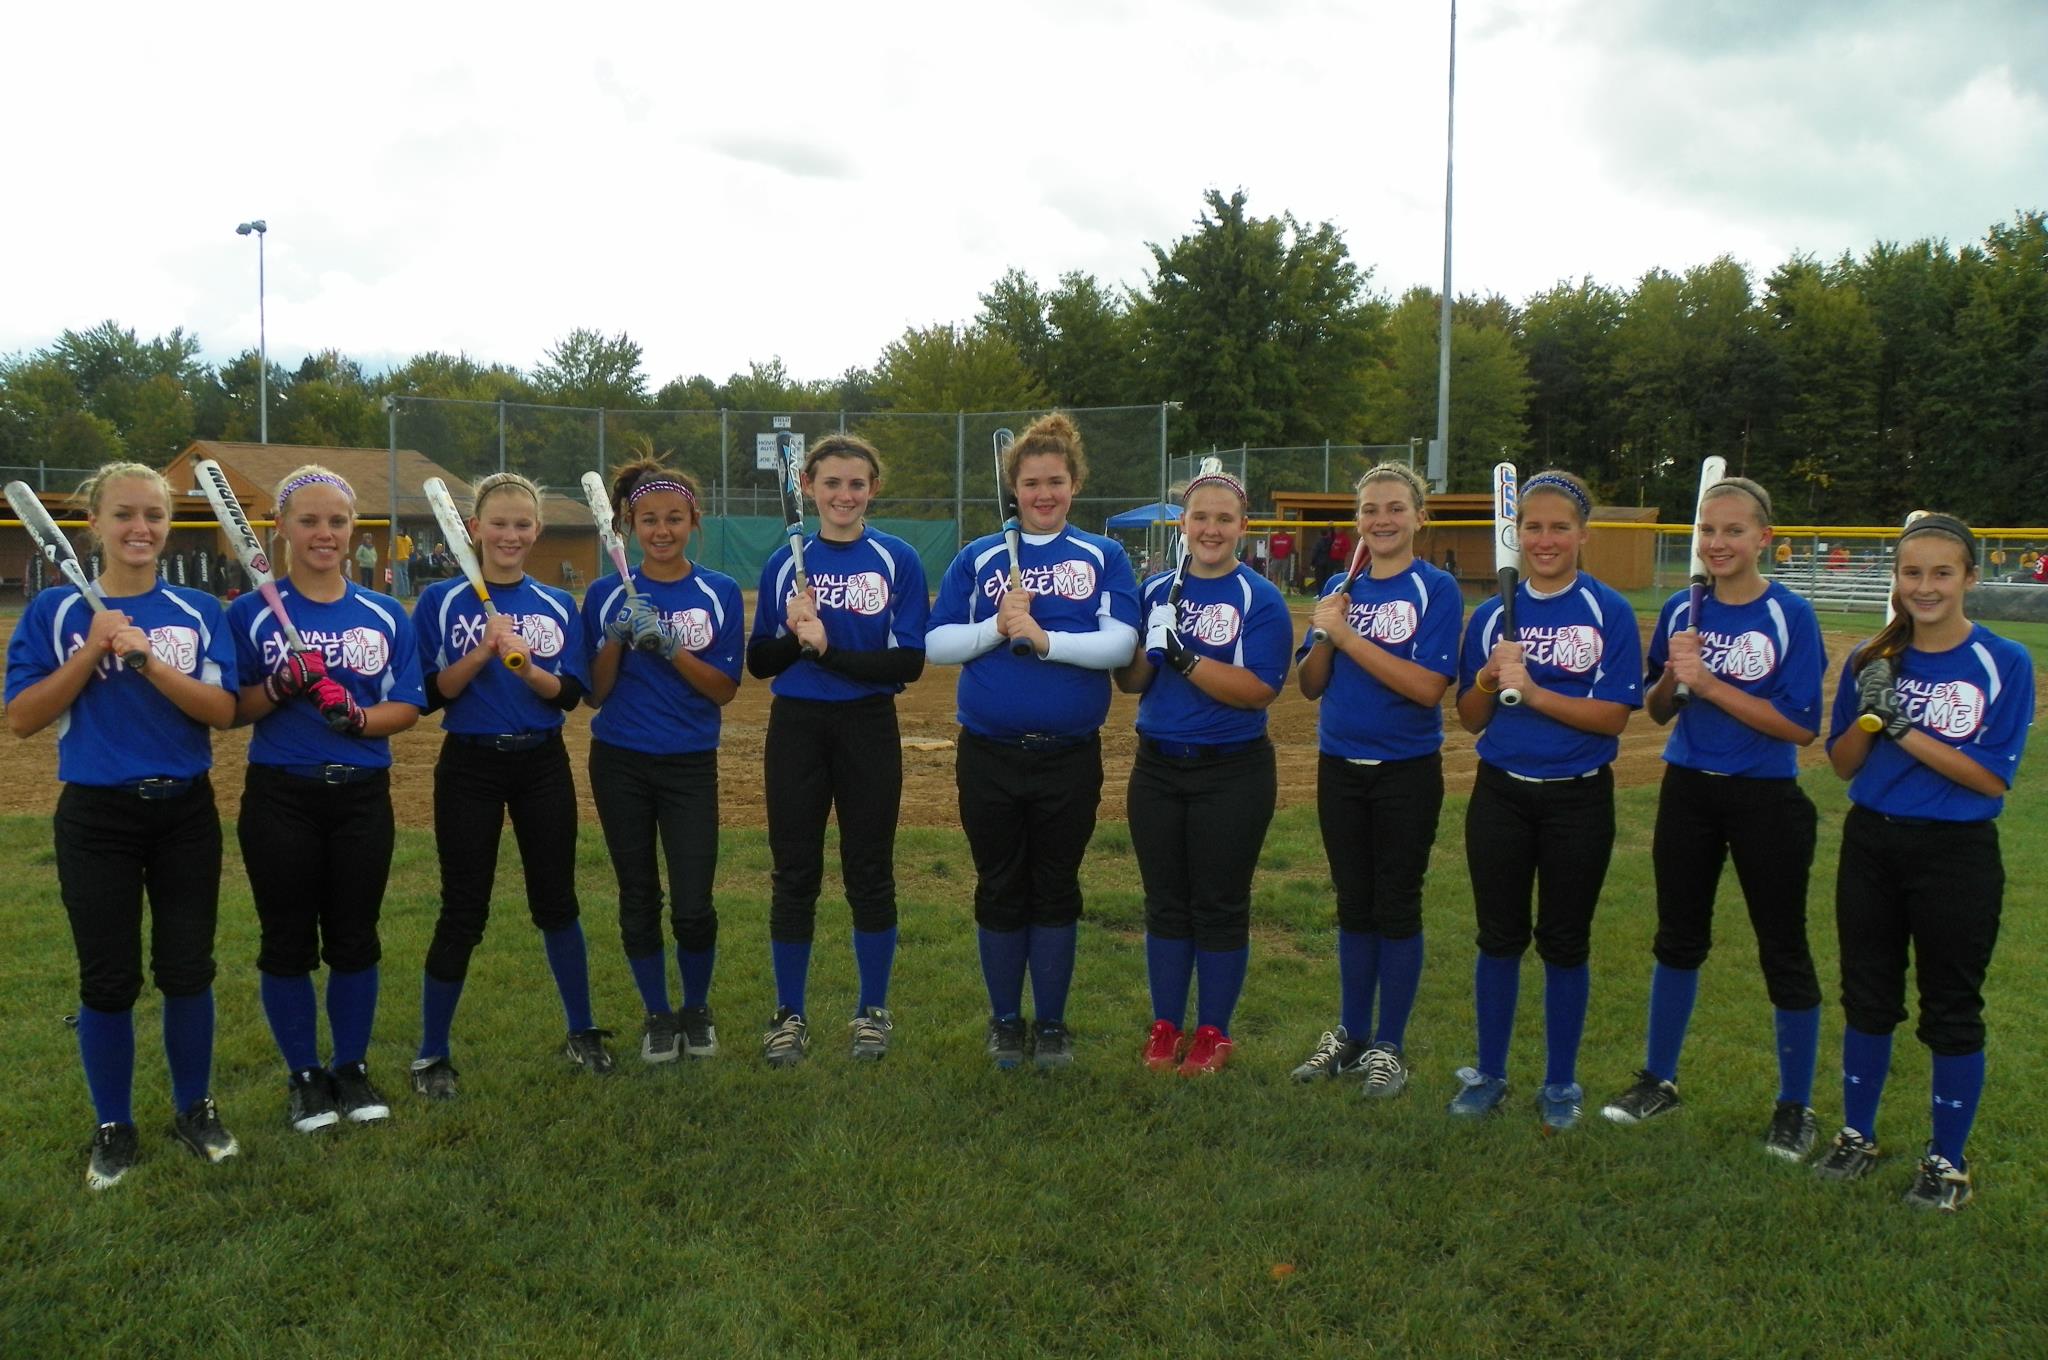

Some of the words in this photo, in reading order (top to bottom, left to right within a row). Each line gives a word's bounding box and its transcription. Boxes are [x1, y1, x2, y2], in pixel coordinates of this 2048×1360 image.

[813, 574, 867, 588] VALLEY
[1019, 562, 1071, 580] VALLEY
[788, 579, 880, 611] REME
[983, 569, 1089, 605] EXREME
[1348, 602, 1397, 616] VALLEY
[299, 629, 364, 644] VALLEY
[451, 614, 556, 656] EXTME
[1347, 614, 1406, 640] REME
[1520, 627, 1578, 642] VALLEY
[263, 631, 379, 673] EXEME
[1504, 637, 1591, 669] REME
[1700, 647, 1763, 677] REME
[1896, 678, 1958, 701] VALLEY
